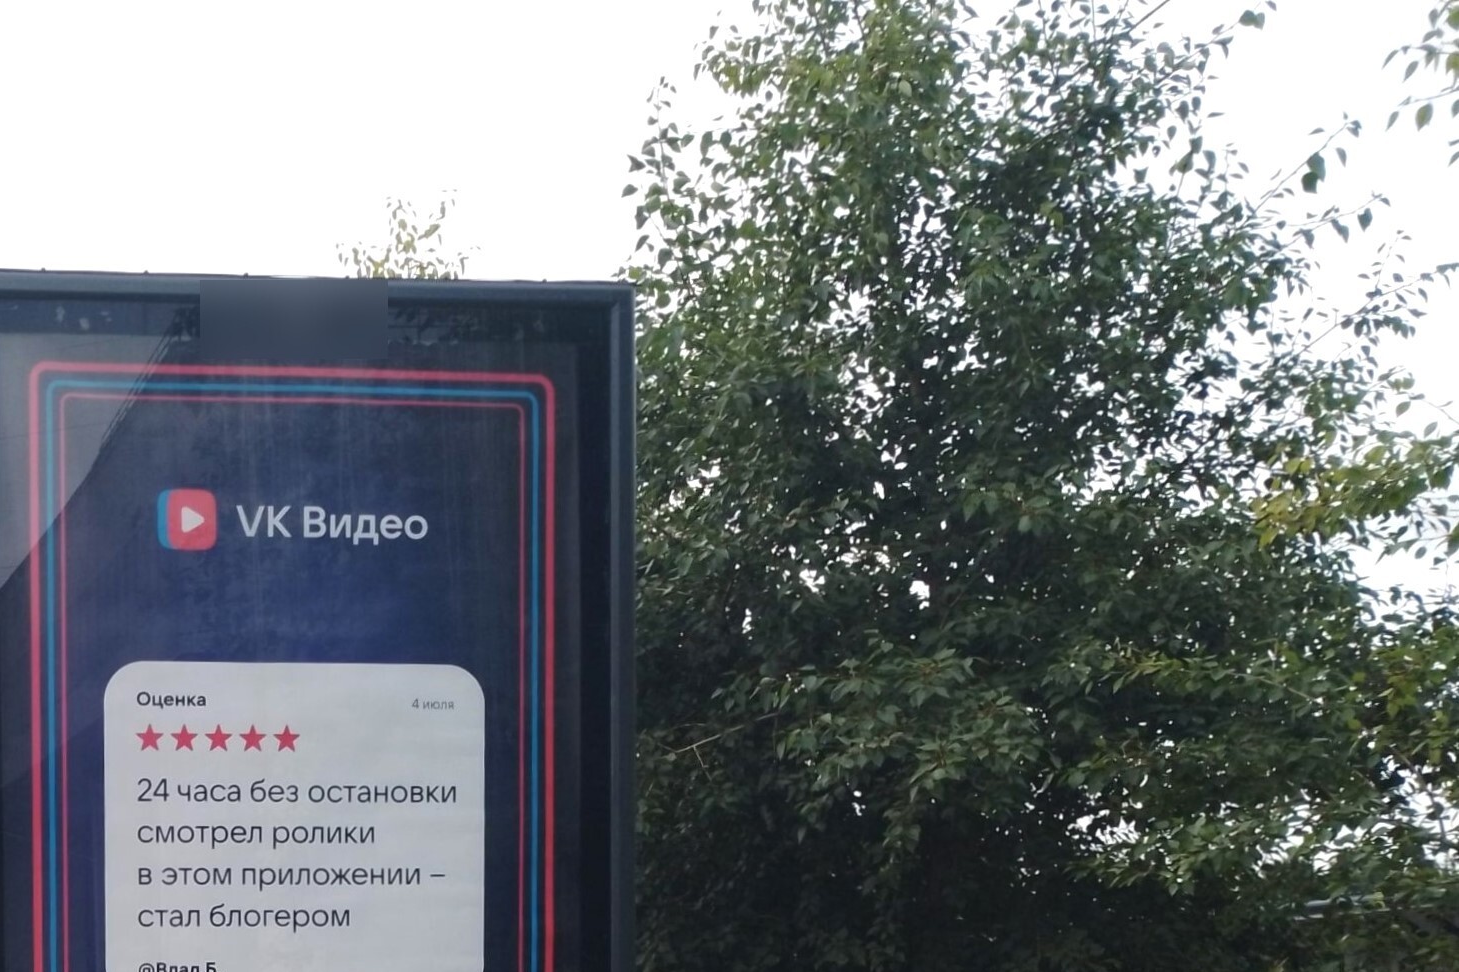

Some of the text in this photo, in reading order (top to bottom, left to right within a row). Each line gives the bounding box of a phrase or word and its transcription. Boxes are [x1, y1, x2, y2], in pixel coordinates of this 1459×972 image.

[236, 505, 428, 545] VK Видео
[136, 692, 207, 709] Оценка
[412, 698, 454, 710] 4 июля
[136, 778, 458, 804] 24 часа без остановки
[137, 825, 376, 850] смотрел ролики
[137, 867, 153, 886] в
[161, 867, 233, 886] этом
[242, 867, 422, 891] приложении
[137, 904, 351, 933] стал блогером
